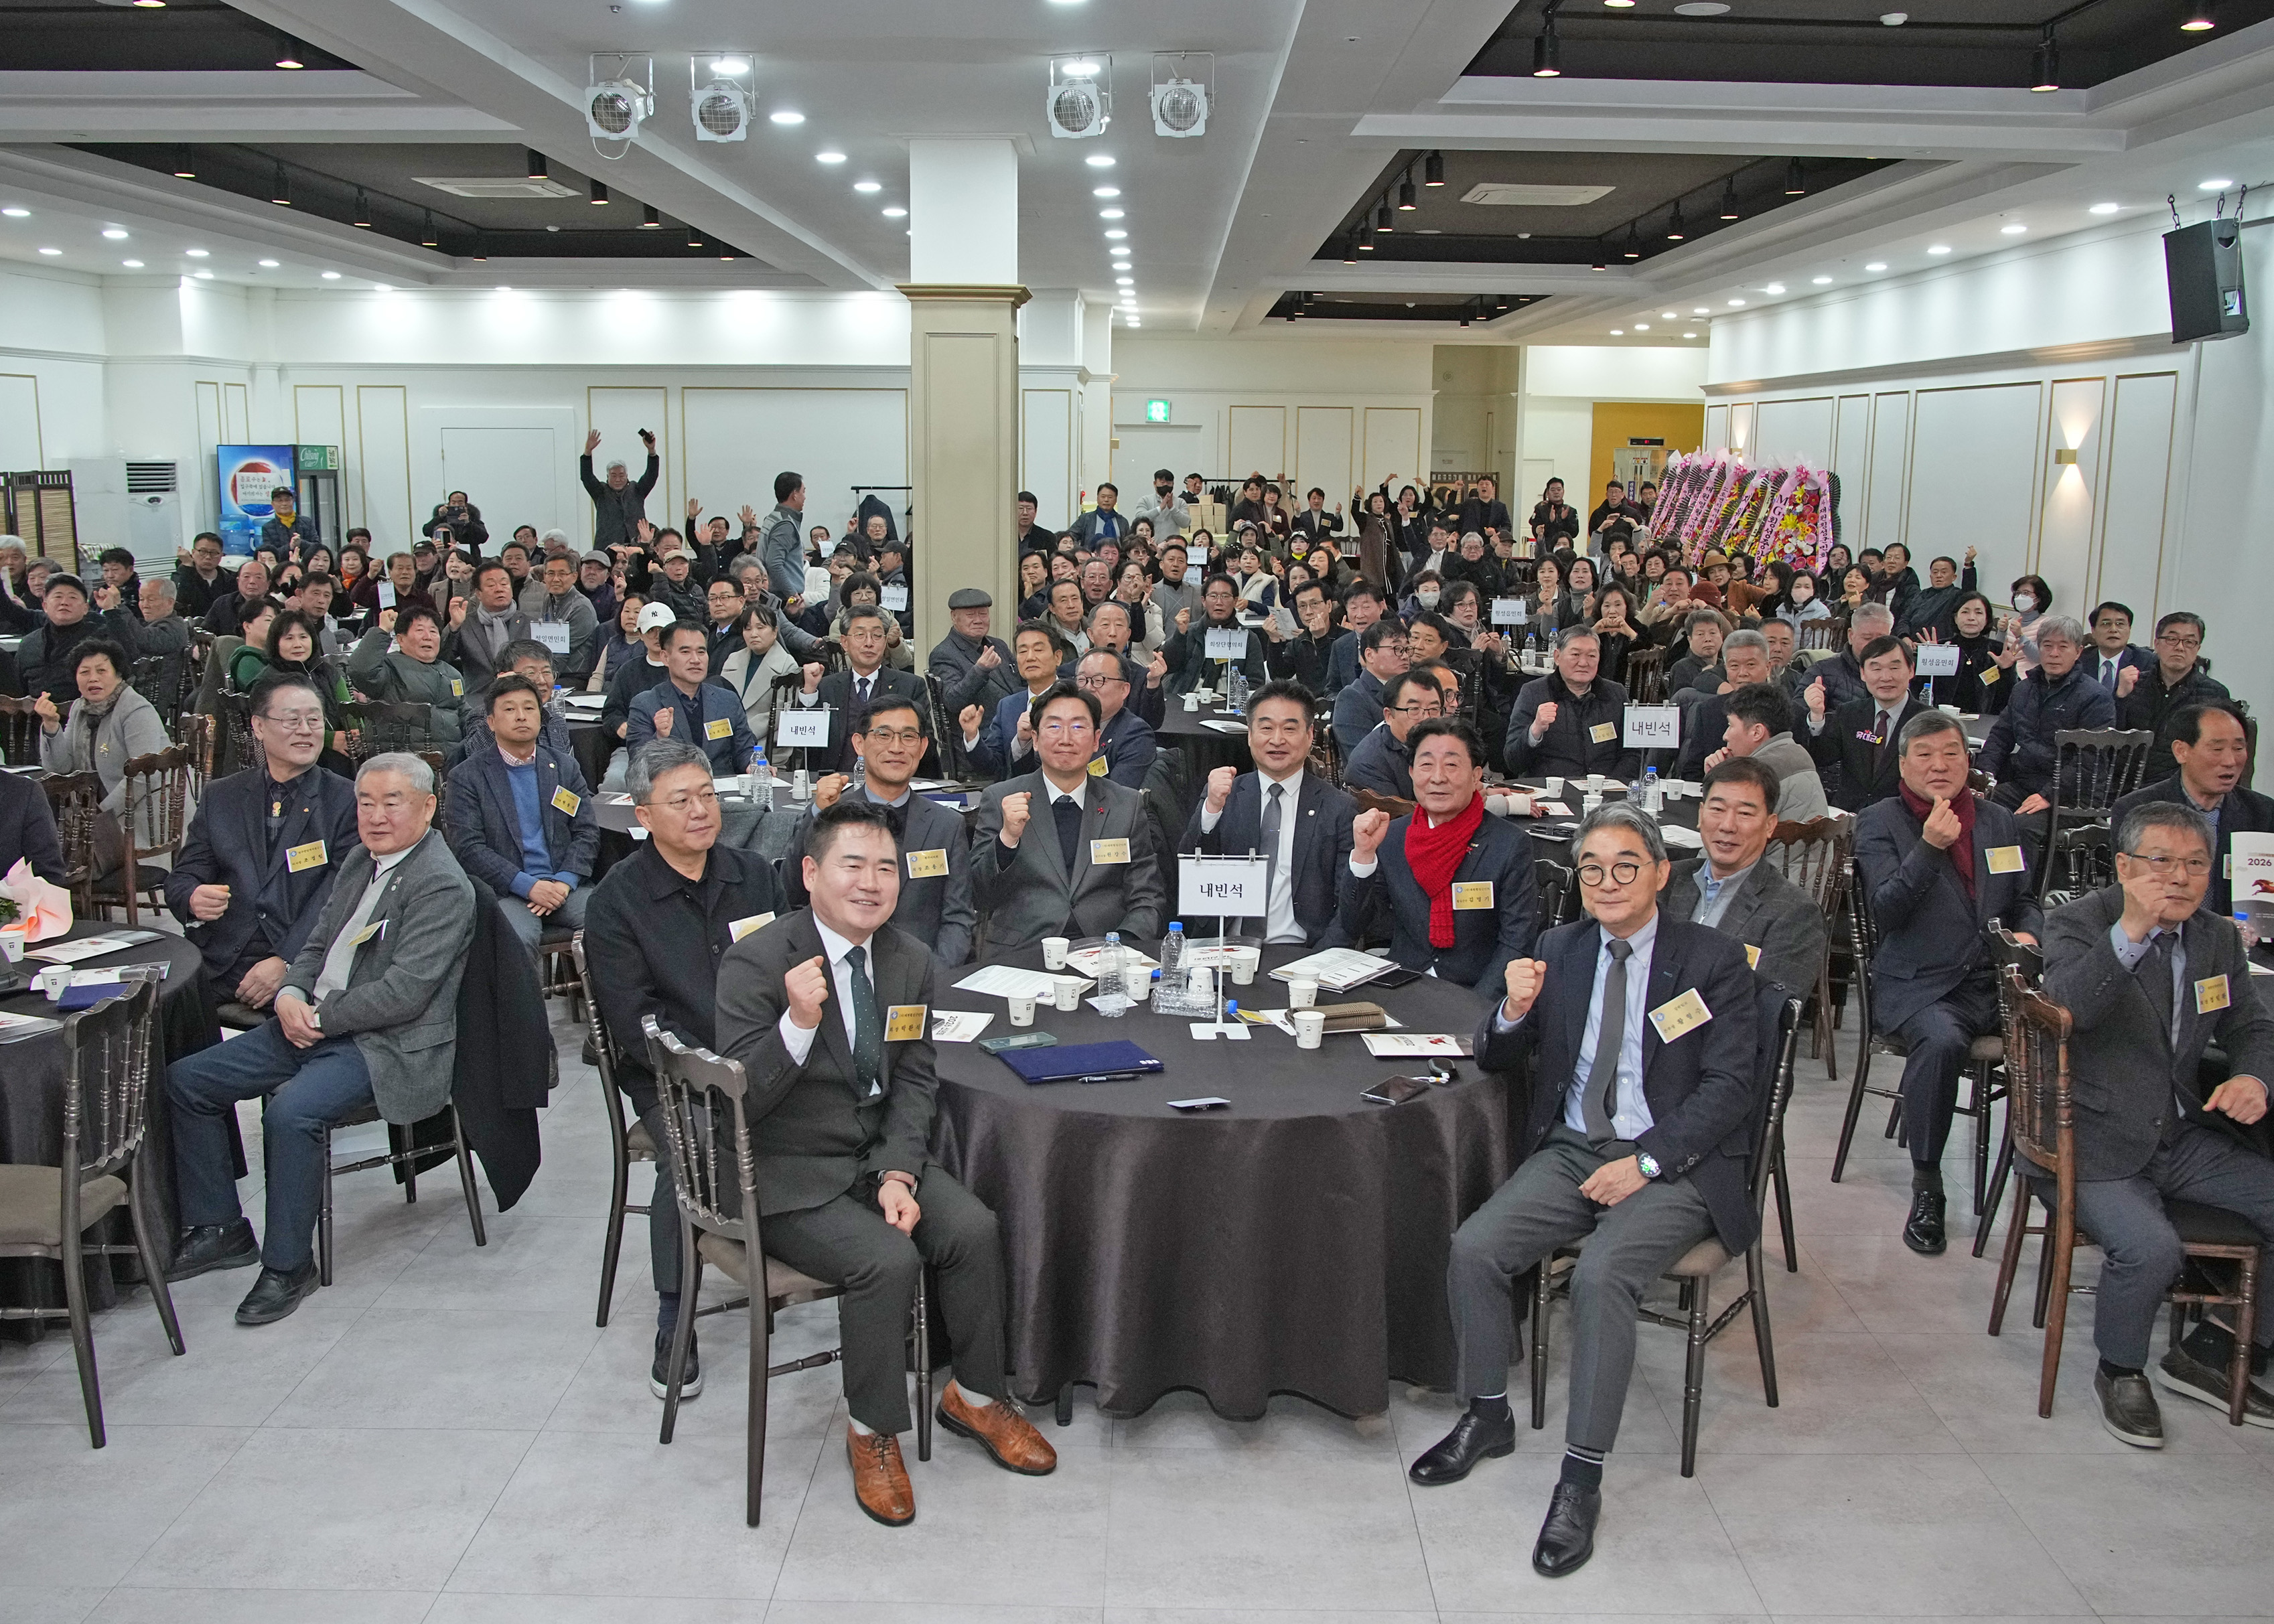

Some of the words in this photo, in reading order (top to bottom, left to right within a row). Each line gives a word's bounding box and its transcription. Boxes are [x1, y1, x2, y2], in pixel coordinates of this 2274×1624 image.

[1922, 658, 1954, 667] 횡성읍민회
[790, 725, 816, 735] 내빈석
[1632, 721, 1671, 736] 내빈석
[2247, 858, 2273, 867] 2026
[1200, 883, 1243, 898] 내빈석
